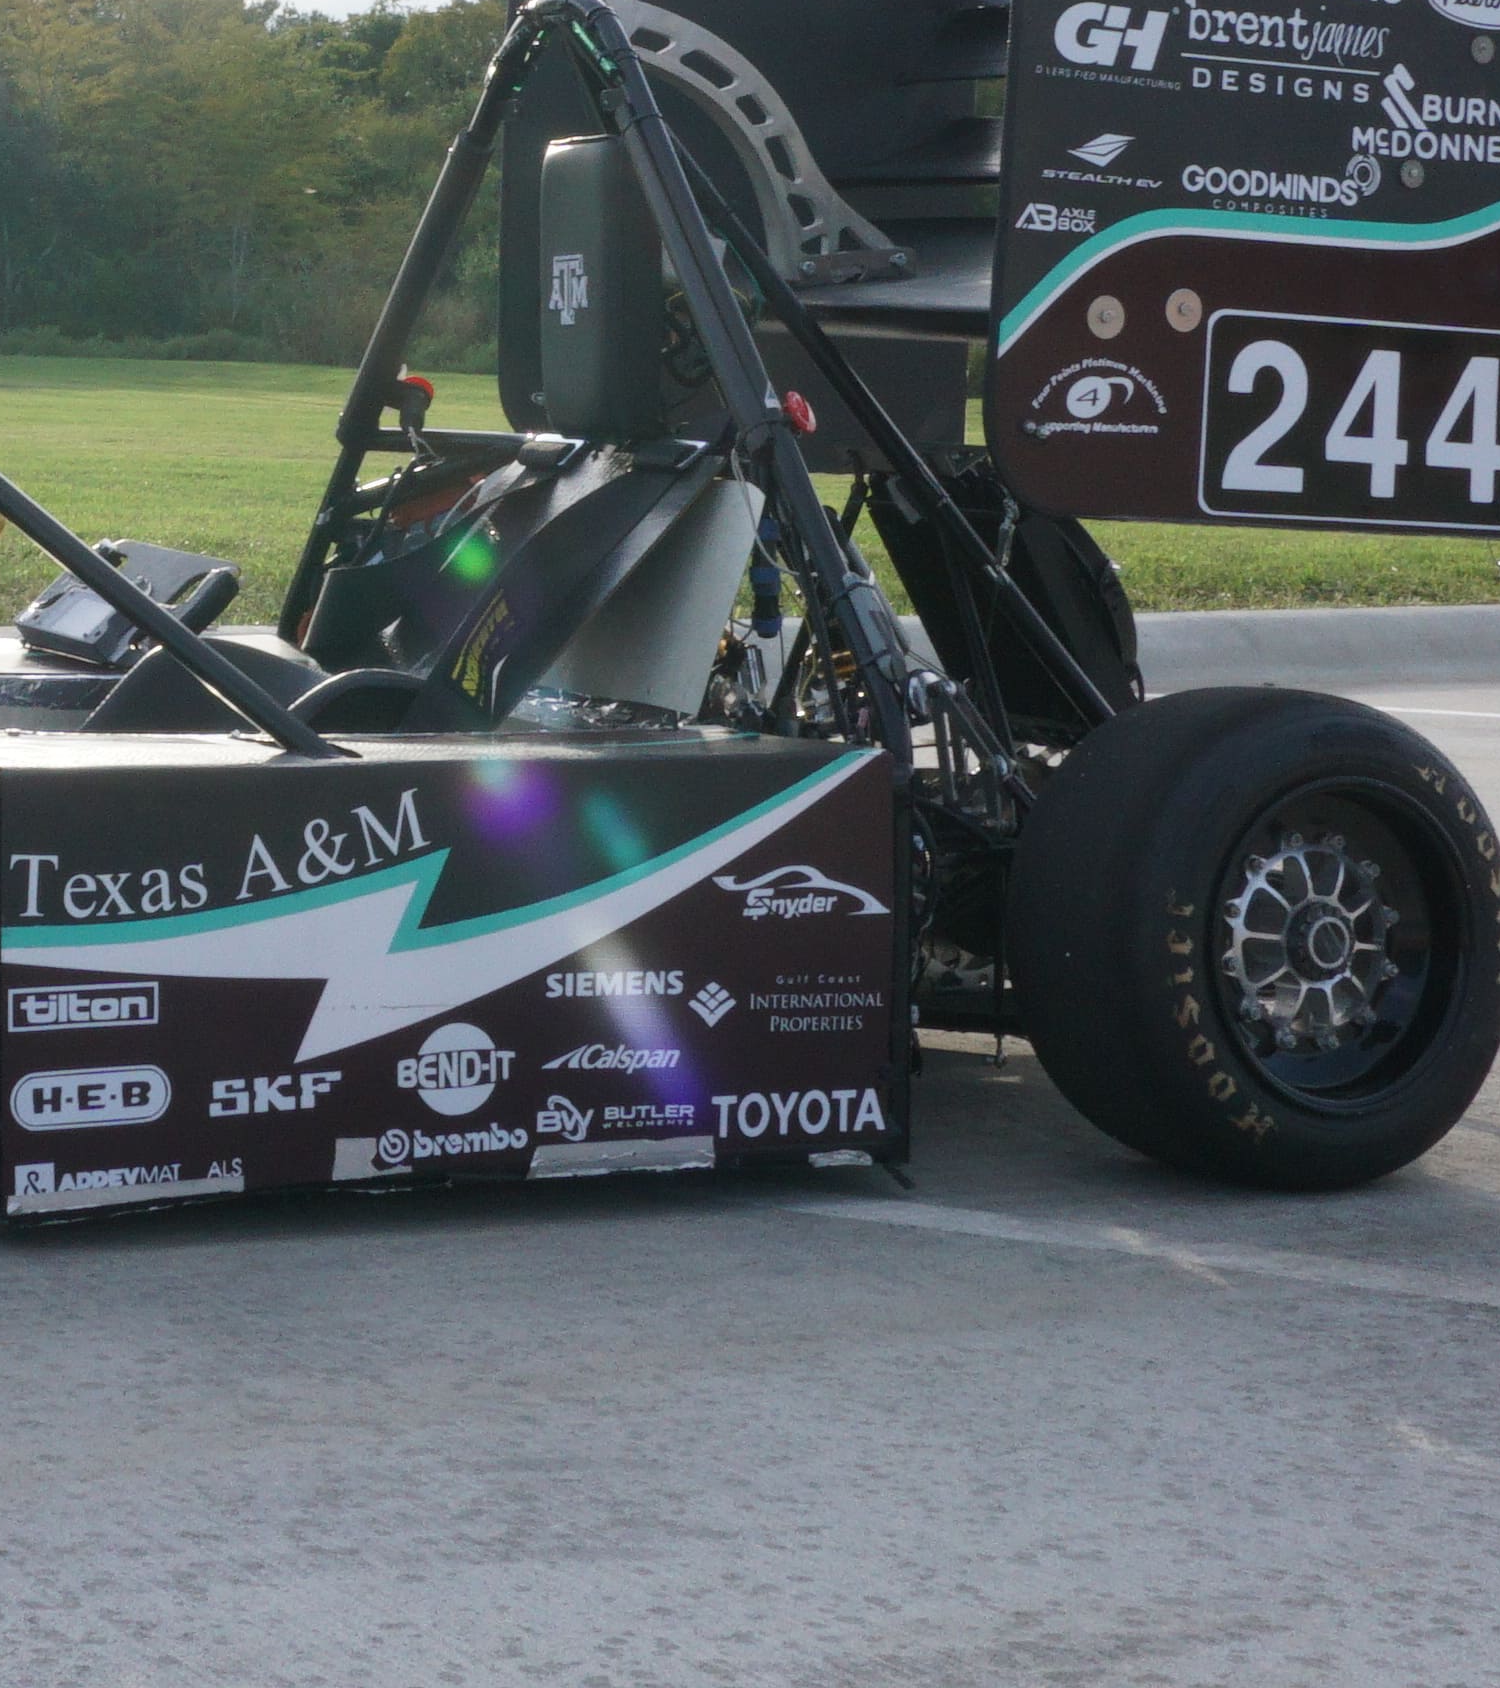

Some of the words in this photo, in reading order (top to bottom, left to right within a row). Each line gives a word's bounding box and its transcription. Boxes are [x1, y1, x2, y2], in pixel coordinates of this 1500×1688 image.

[1192, 67, 1370, 103] DESIGNS
[1041, 169, 1132, 188] STEALTH
[1135, 179, 1163, 189] EV
[1181, 164, 1359, 207] GOODWINDS
[1061, 207, 1096, 220] AXLE
[1212, 198, 1328, 219] COMPOSITES
[1058, 217, 1096, 234] BOX
[9, 853, 209, 918] Texas
[235, 787, 431, 900] A&M
[743, 888, 838, 920] Snyder
[545, 970, 685, 998] SIEMENS
[776, 974, 809, 985] Gulf
[20, 993, 149, 1024] tilton
[750, 991, 884, 1010] INTERNATIONAL
[770, 1015, 864, 1033] PROPERTIES
[397, 1050, 516, 1090] BEND-IT
[580, 1044, 681, 1075] Calspan
[209, 1070, 342, 1118] SKF
[604, 1104, 695, 1120] BUTLER
[711, 1087, 886, 1139] TOYOTA
[413, 1122, 529, 1159] brembo
